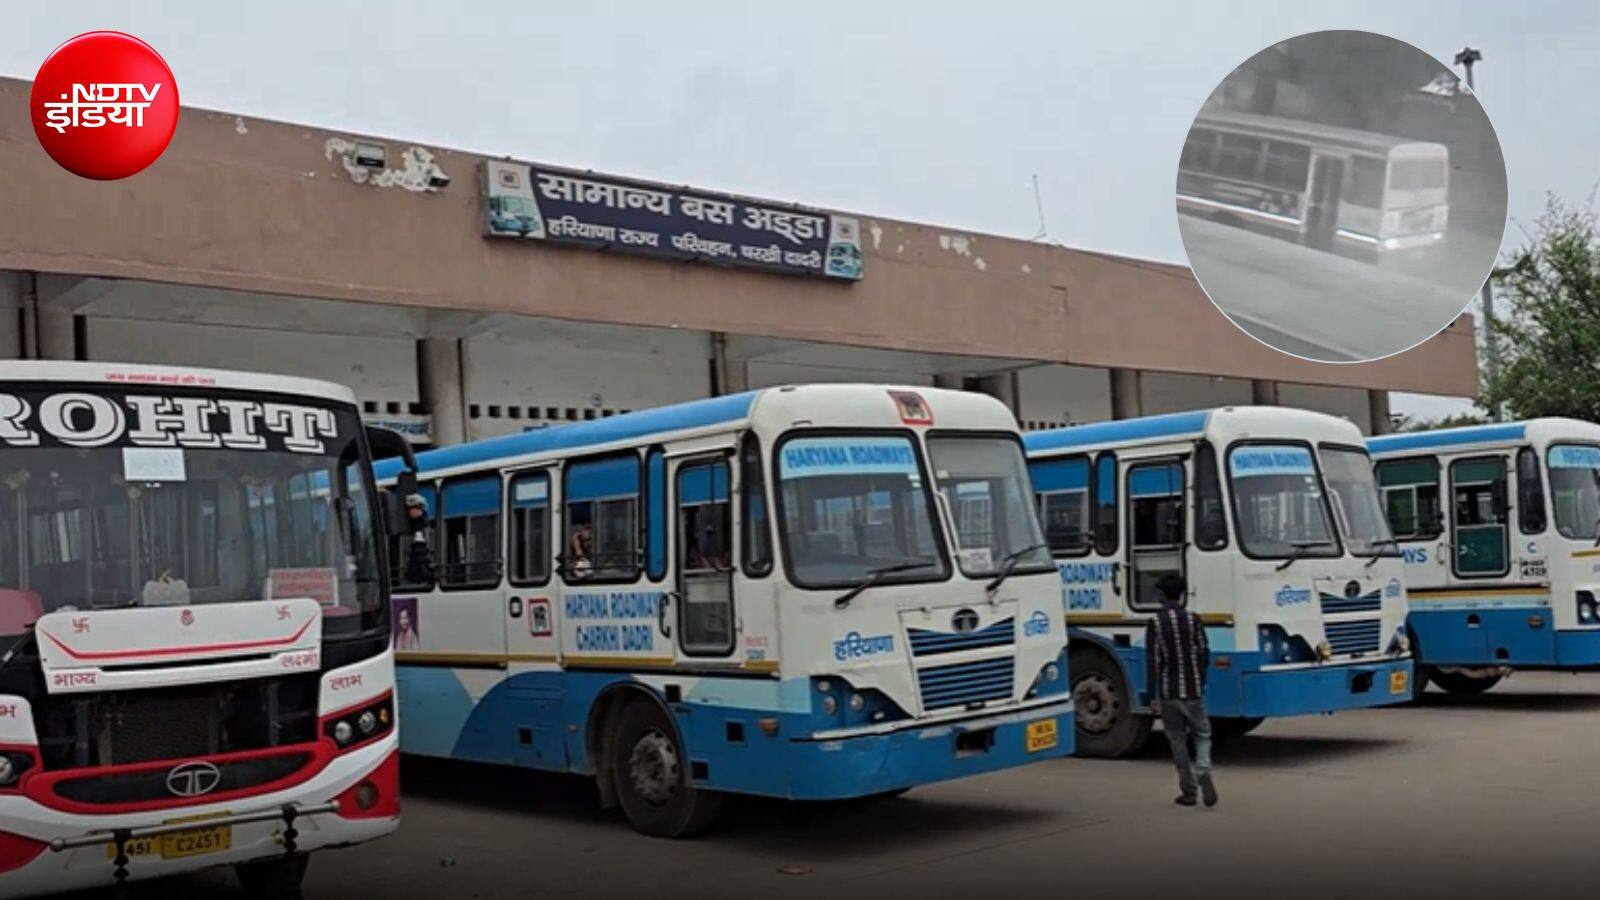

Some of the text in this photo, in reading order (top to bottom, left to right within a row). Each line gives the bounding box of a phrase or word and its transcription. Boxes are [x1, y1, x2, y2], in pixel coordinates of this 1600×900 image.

[536, 173, 673, 216] सामान्य
[679, 195, 735, 225] बस
[547, 214, 616, 242] हरियाणा
[618, 229, 660, 247] राज्य
[1059, 562, 1113, 584] ROADWAY
[564, 591, 664, 619] HARYANA ROADWAY
[1069, 588, 1102, 610] DADRI
[576, 624, 654, 651] CHARKHI DADRI
[833, 630, 894, 661] हरियाणा
[125, 839, 151, 857] 451
